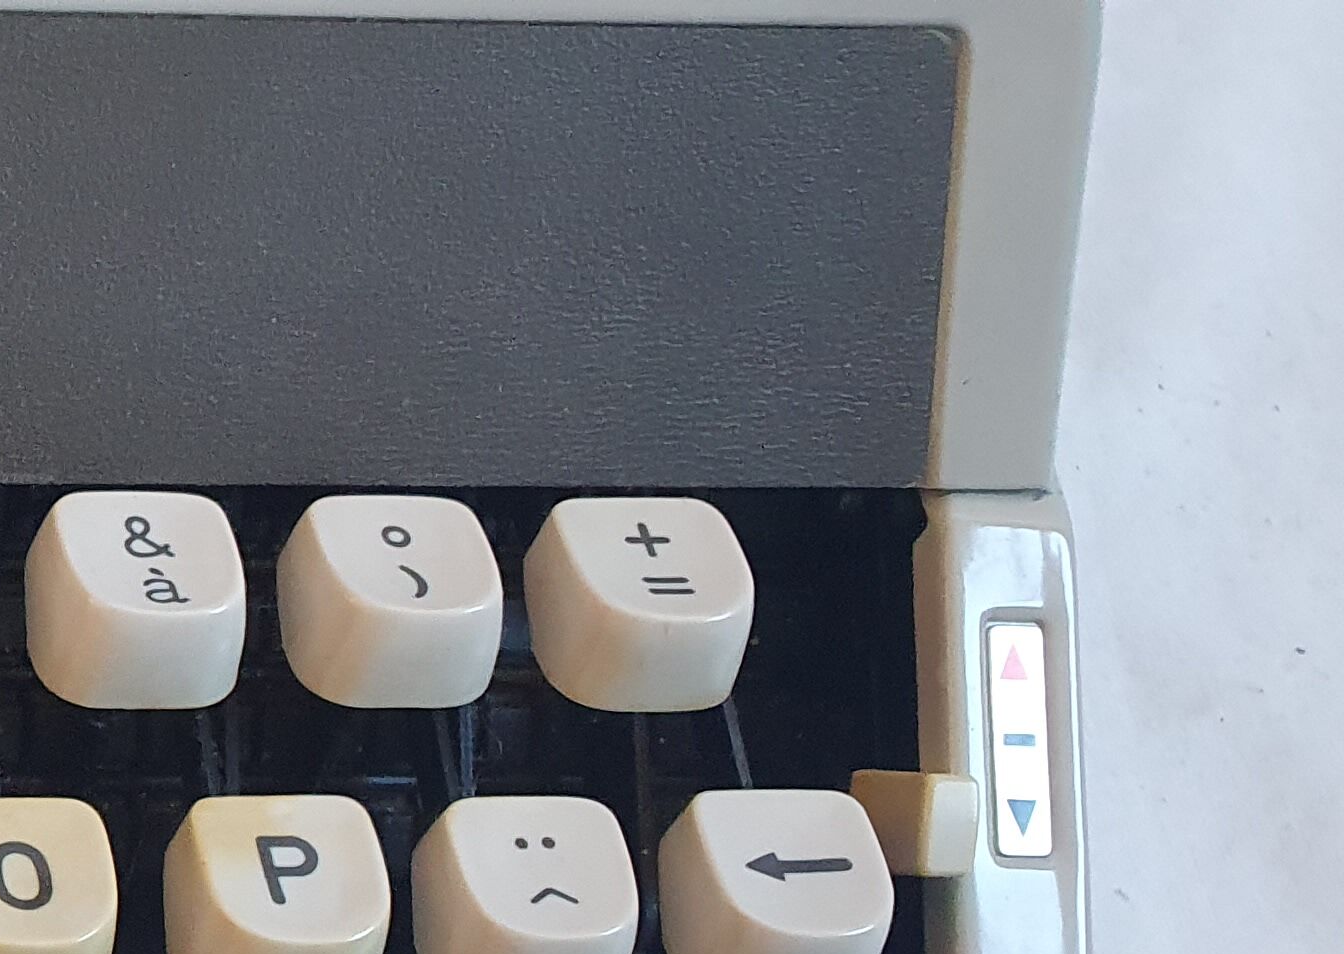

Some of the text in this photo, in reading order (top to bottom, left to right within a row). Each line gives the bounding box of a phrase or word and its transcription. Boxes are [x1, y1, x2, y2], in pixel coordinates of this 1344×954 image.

[122, 514, 177, 560] &
[623, 520, 673, 559] +
[141, 566, 193, 605] à
[397, 563, 430, 600] )
[640, 575, 698, 597] =
[253, 834, 320, 907] P
